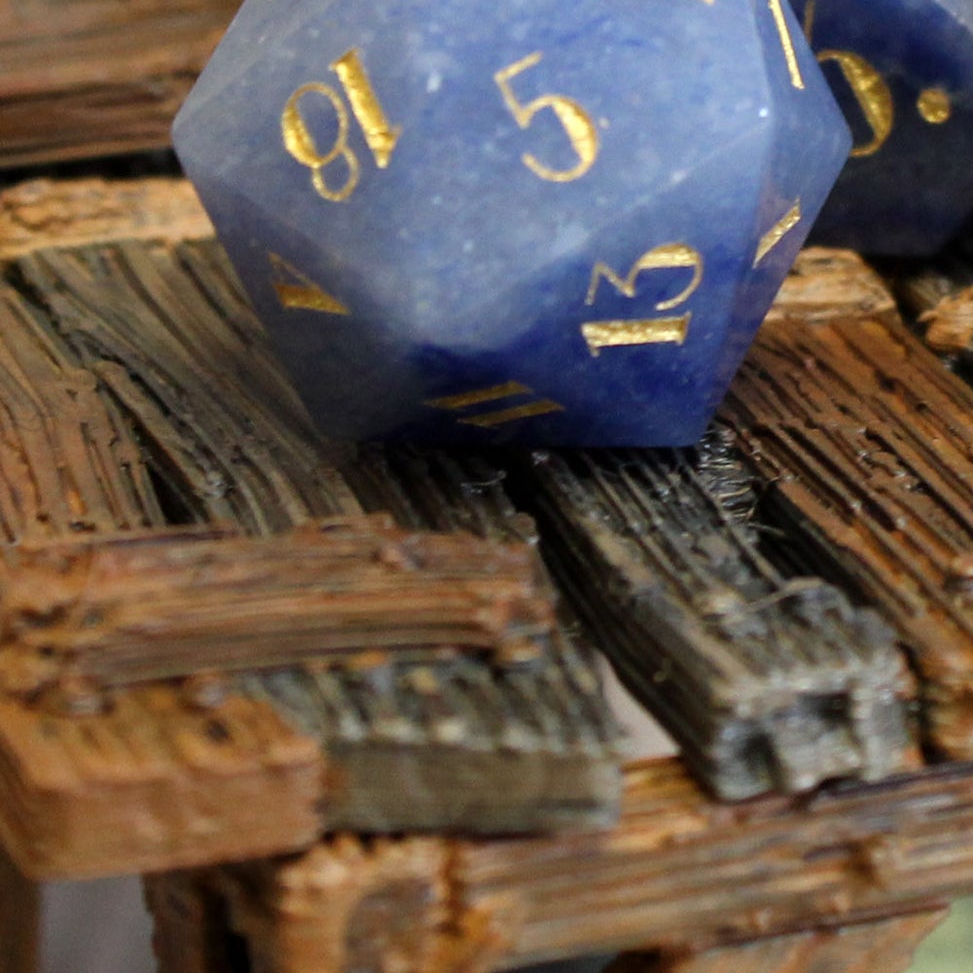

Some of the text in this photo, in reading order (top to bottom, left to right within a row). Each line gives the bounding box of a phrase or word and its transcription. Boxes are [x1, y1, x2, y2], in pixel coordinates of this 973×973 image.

[280, 48, 399, 203] 18
[494, 52, 600, 183] 5
[580, 242, 703, 358] 13
